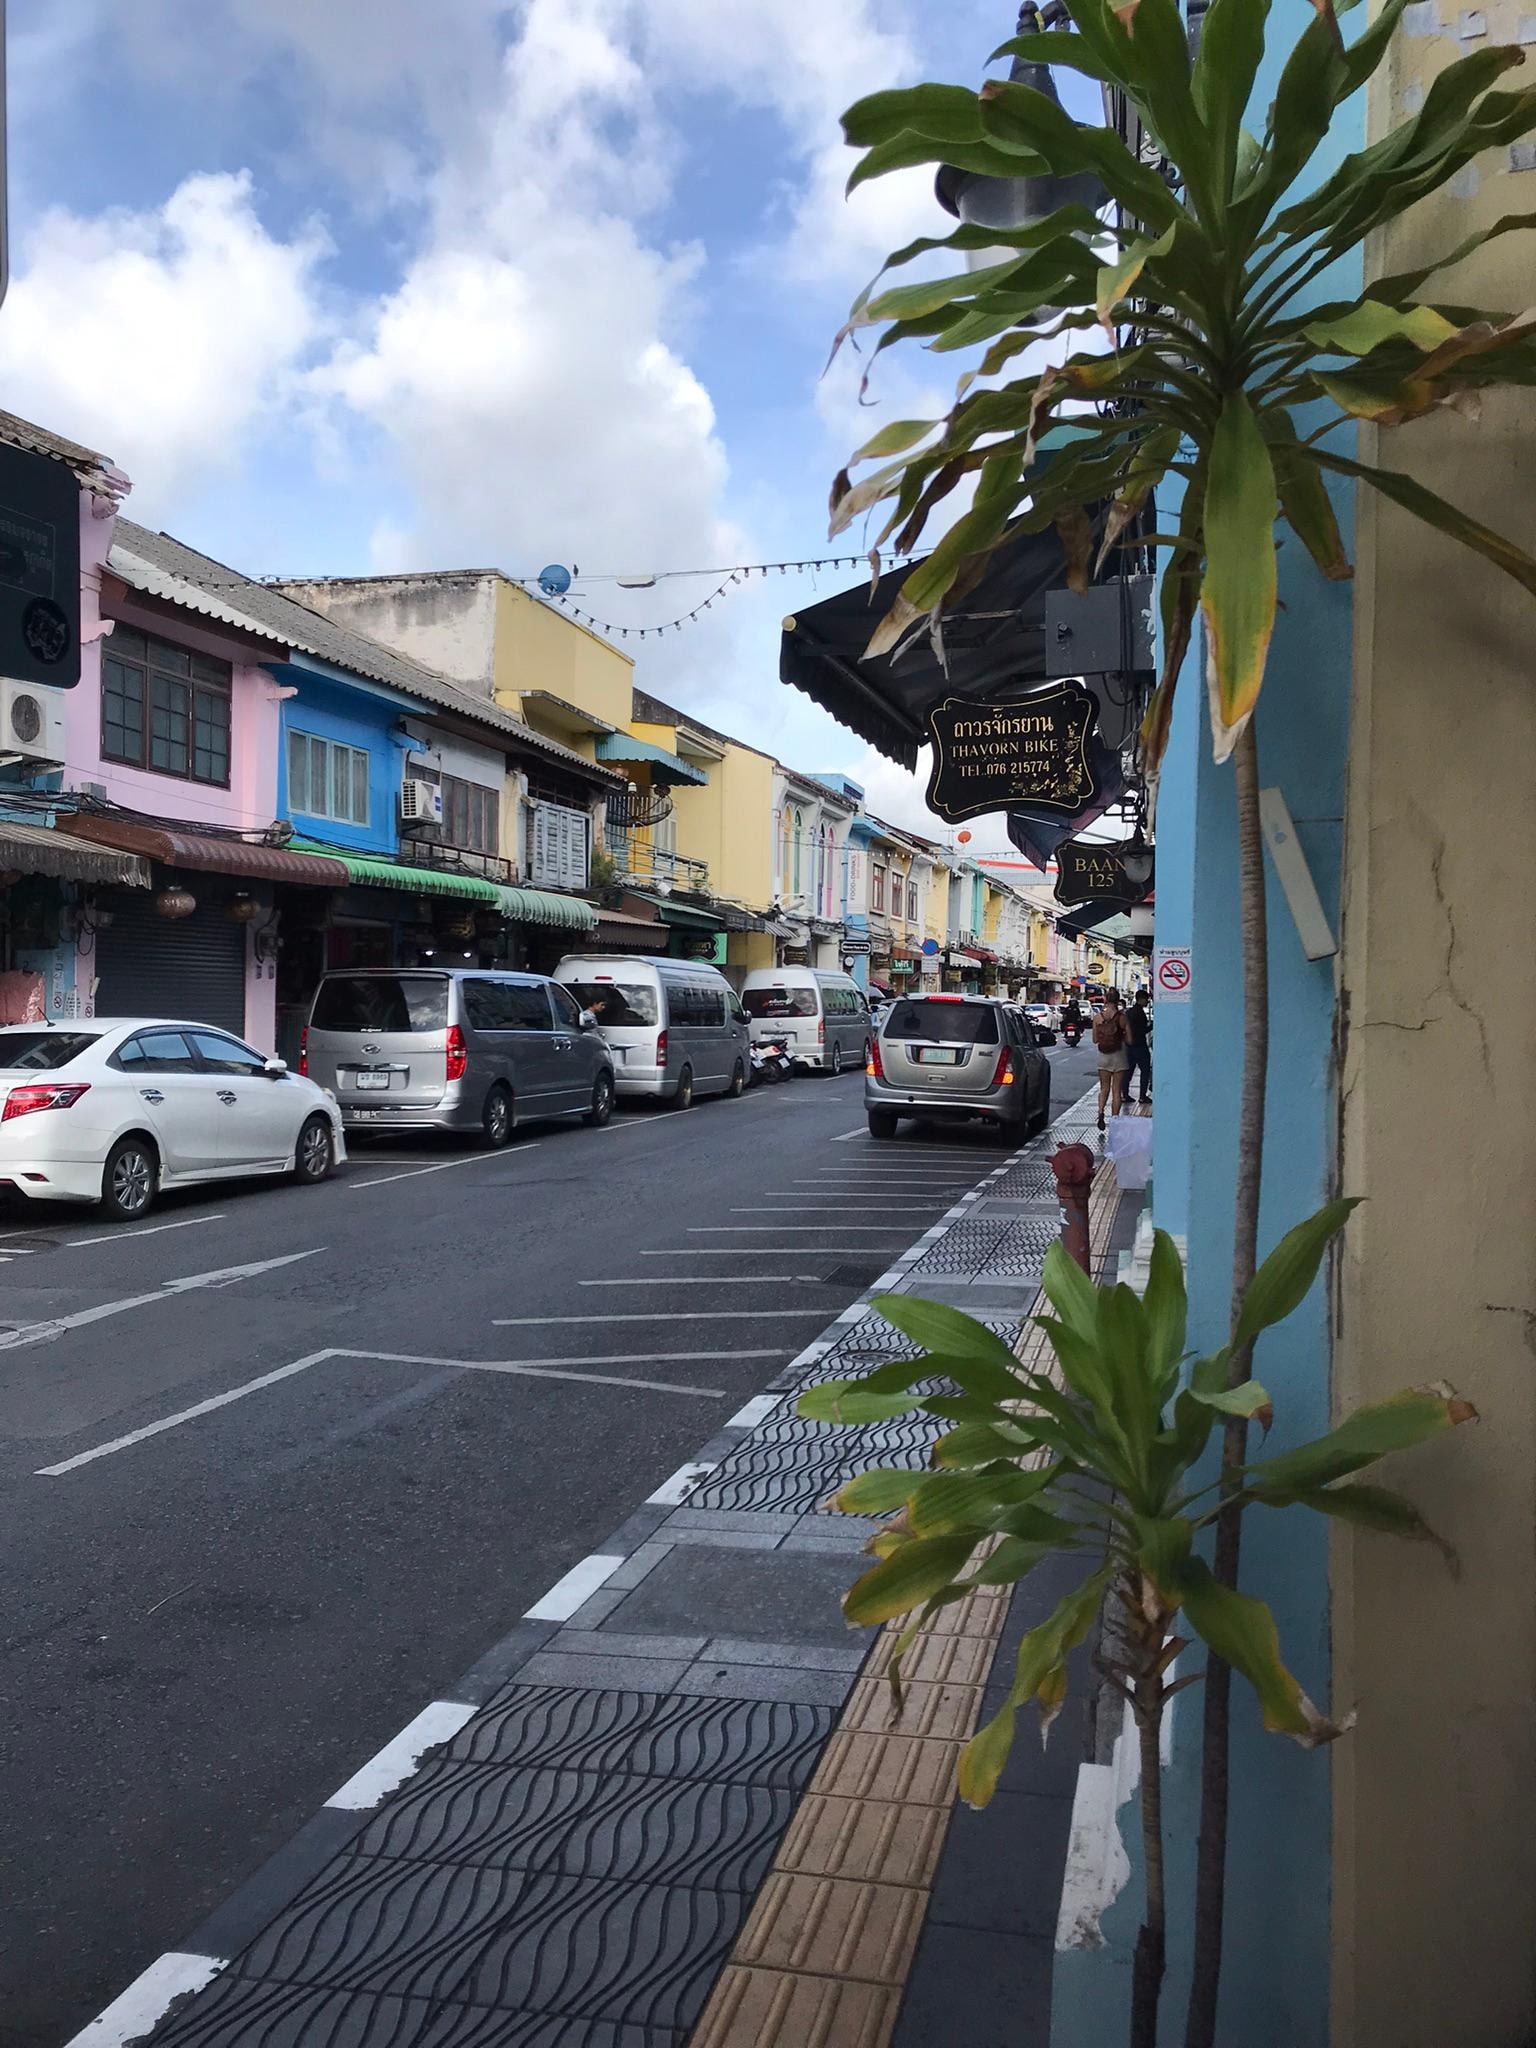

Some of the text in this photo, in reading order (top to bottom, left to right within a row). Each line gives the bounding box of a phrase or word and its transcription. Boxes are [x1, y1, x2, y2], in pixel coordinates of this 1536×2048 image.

[954, 708, 1054, 738] ถาวรจักรยาน
[951, 739, 1059, 758] THAVORN BIKE
[1011, 760, 1050, 774] 215774
[1088, 873, 1114, 887] 125
